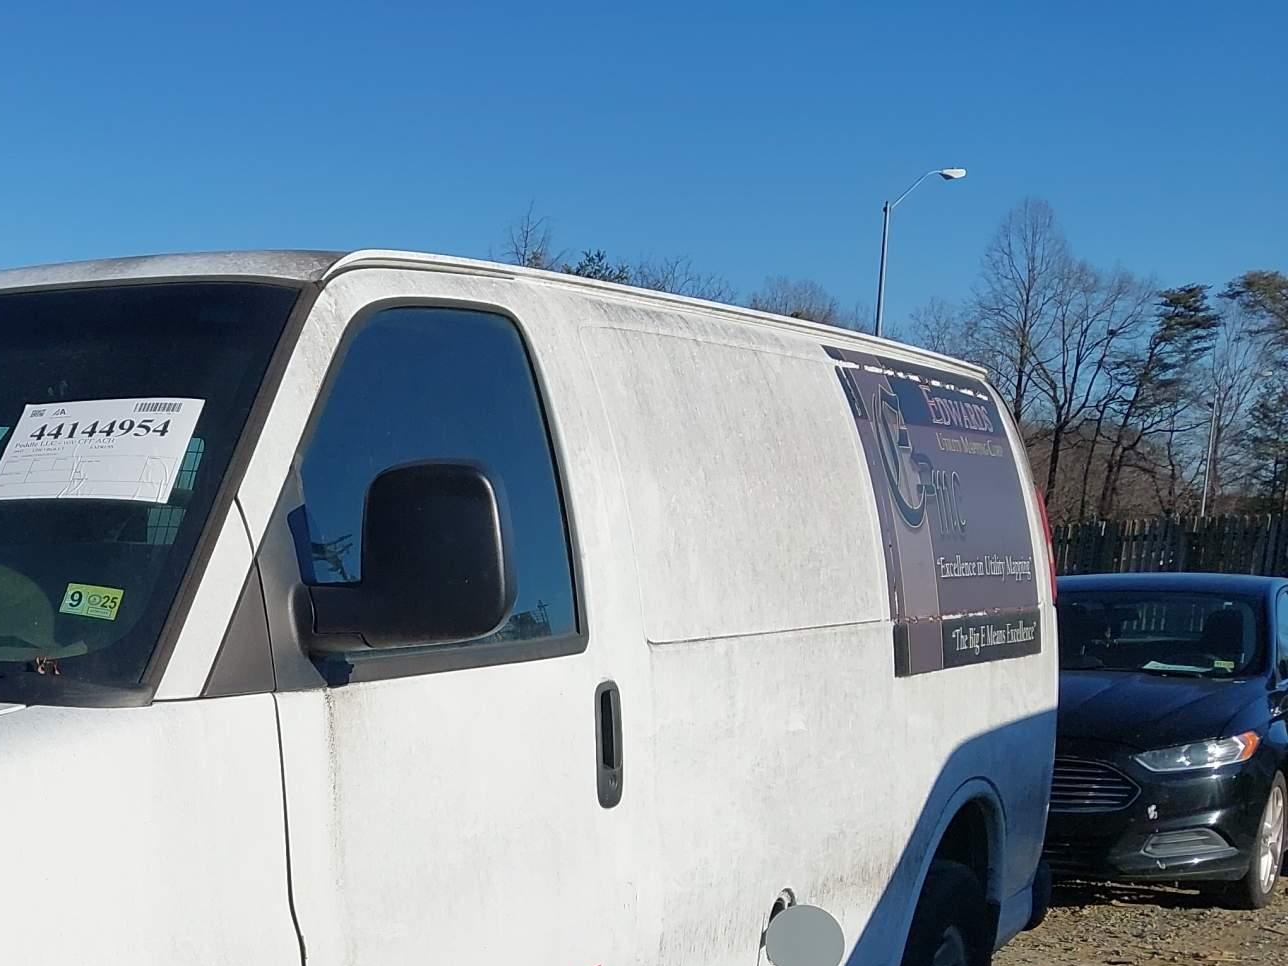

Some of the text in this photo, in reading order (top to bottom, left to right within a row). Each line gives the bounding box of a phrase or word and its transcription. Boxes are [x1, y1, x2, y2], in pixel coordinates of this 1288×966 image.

[29, 418, 170, 441] 44144954
[69, 591, 118, 609] 9 25
[969, 627, 980, 655] Big
[981, 626, 986, 647] E
[986, 625, 1006, 646] Means
